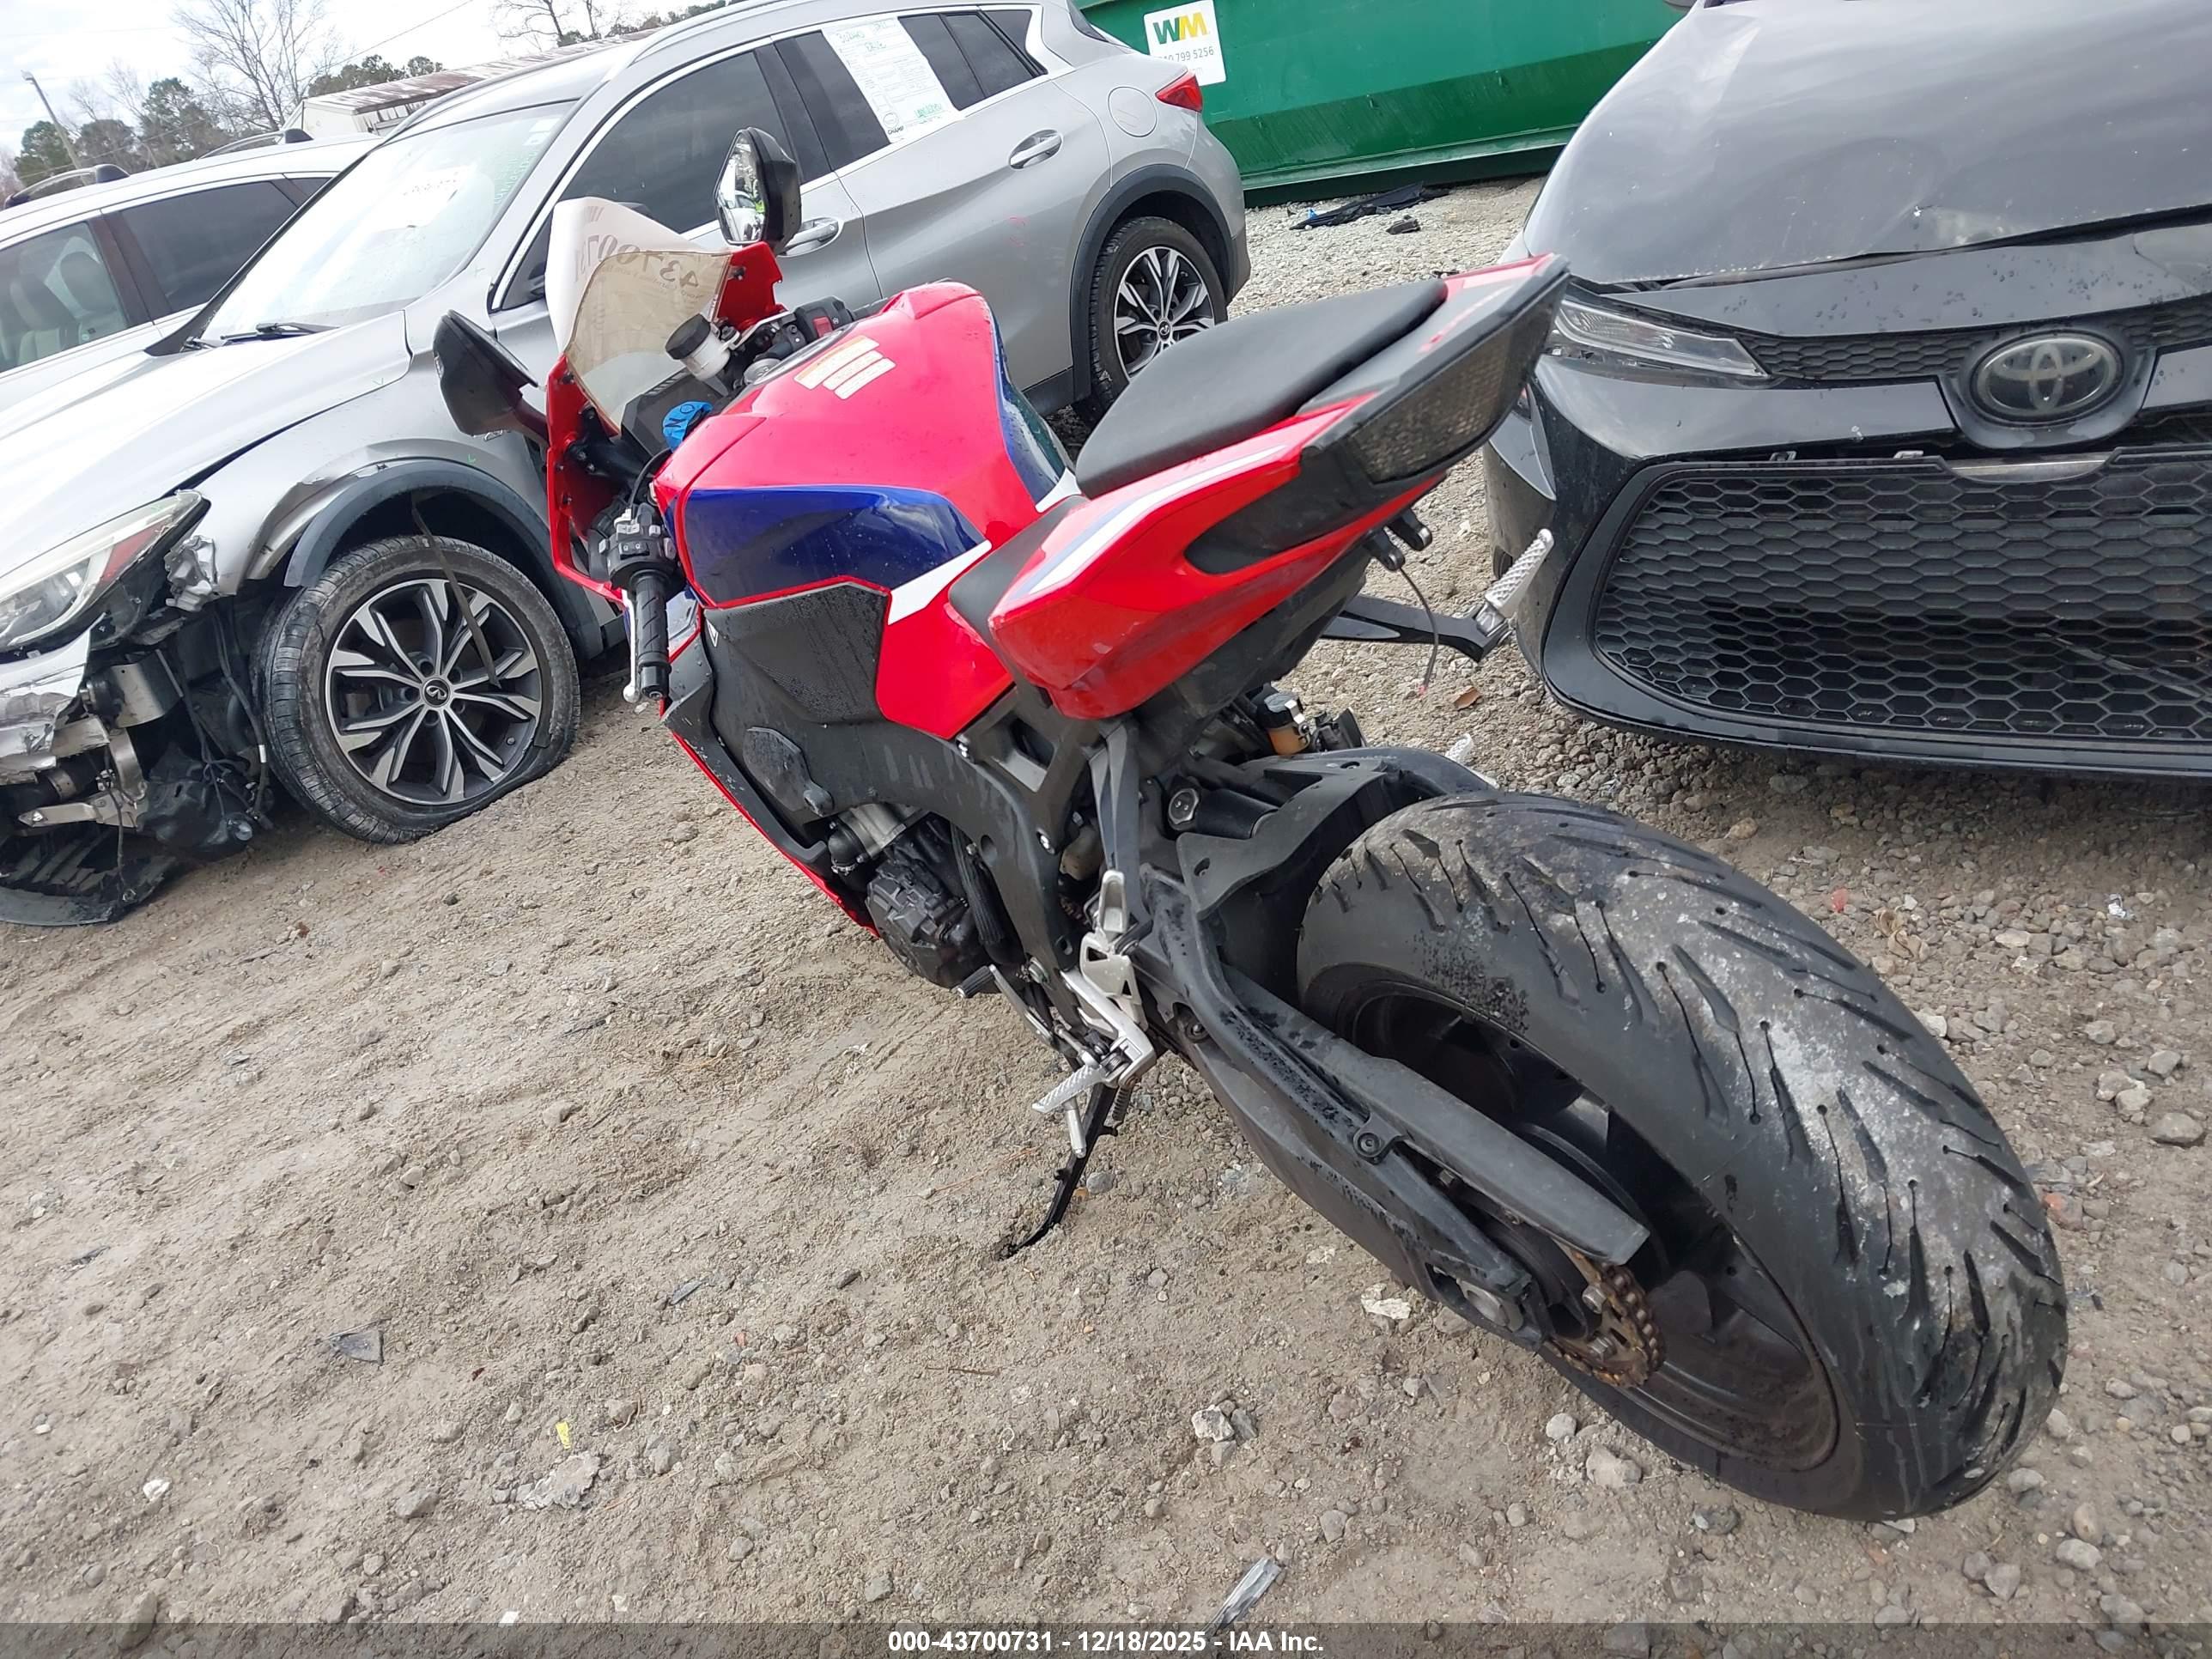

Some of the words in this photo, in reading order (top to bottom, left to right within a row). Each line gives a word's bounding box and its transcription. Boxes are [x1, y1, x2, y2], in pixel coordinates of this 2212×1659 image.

[1152, 12, 1207, 45] WM
[1175, 51, 1191, 62] 799
[1193, 46, 1214, 59] 5256
